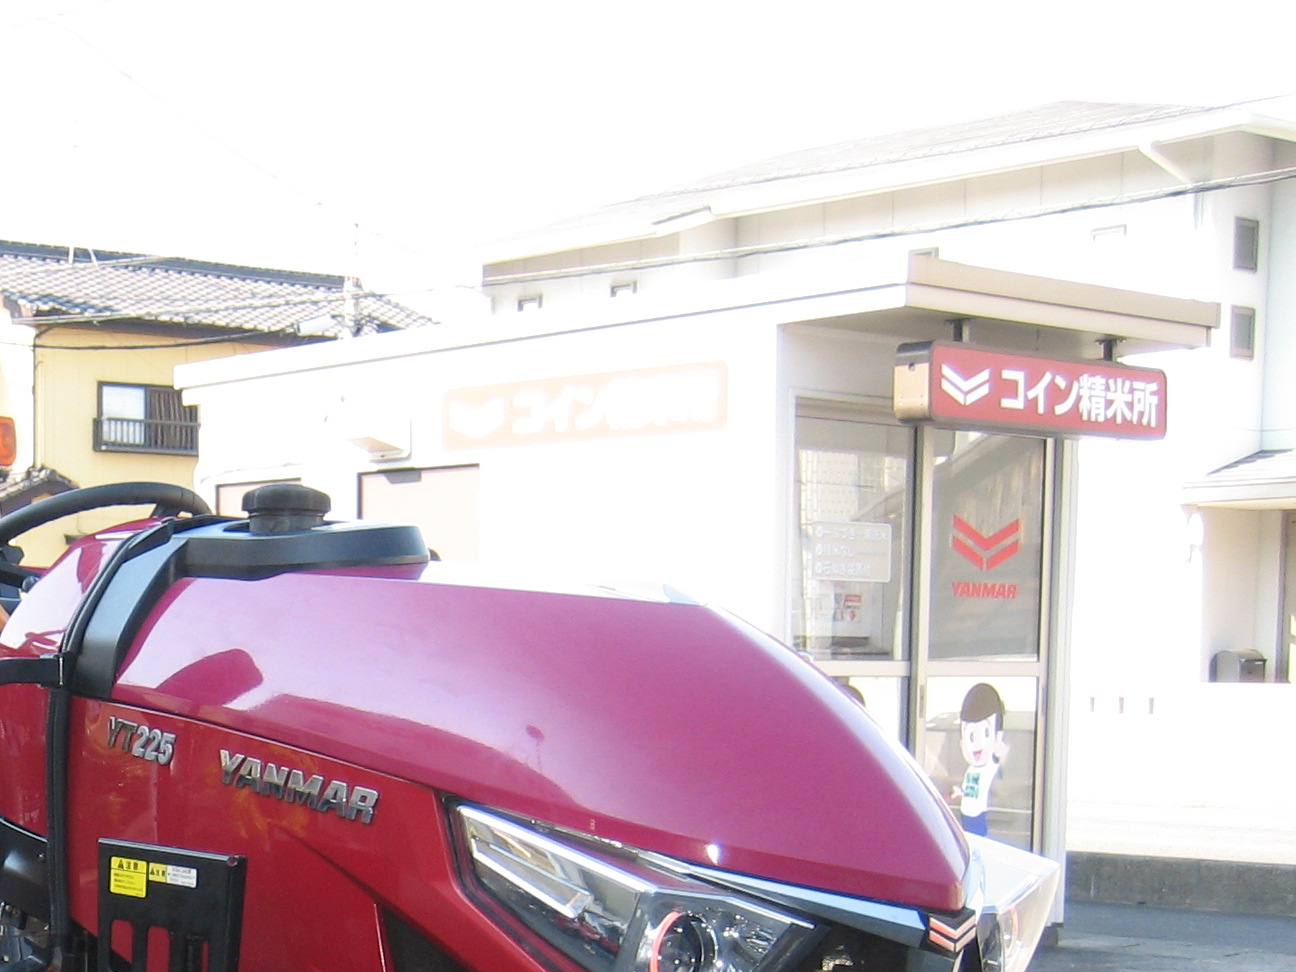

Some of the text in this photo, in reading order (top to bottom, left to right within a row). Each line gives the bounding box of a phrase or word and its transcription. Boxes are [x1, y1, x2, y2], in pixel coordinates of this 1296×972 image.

[1000, 369, 1158, 428] コイン精米所
[952, 581, 1018, 599] YANMAR
[107, 715, 176, 766] YT225
[219, 748, 379, 825] YANMAR
